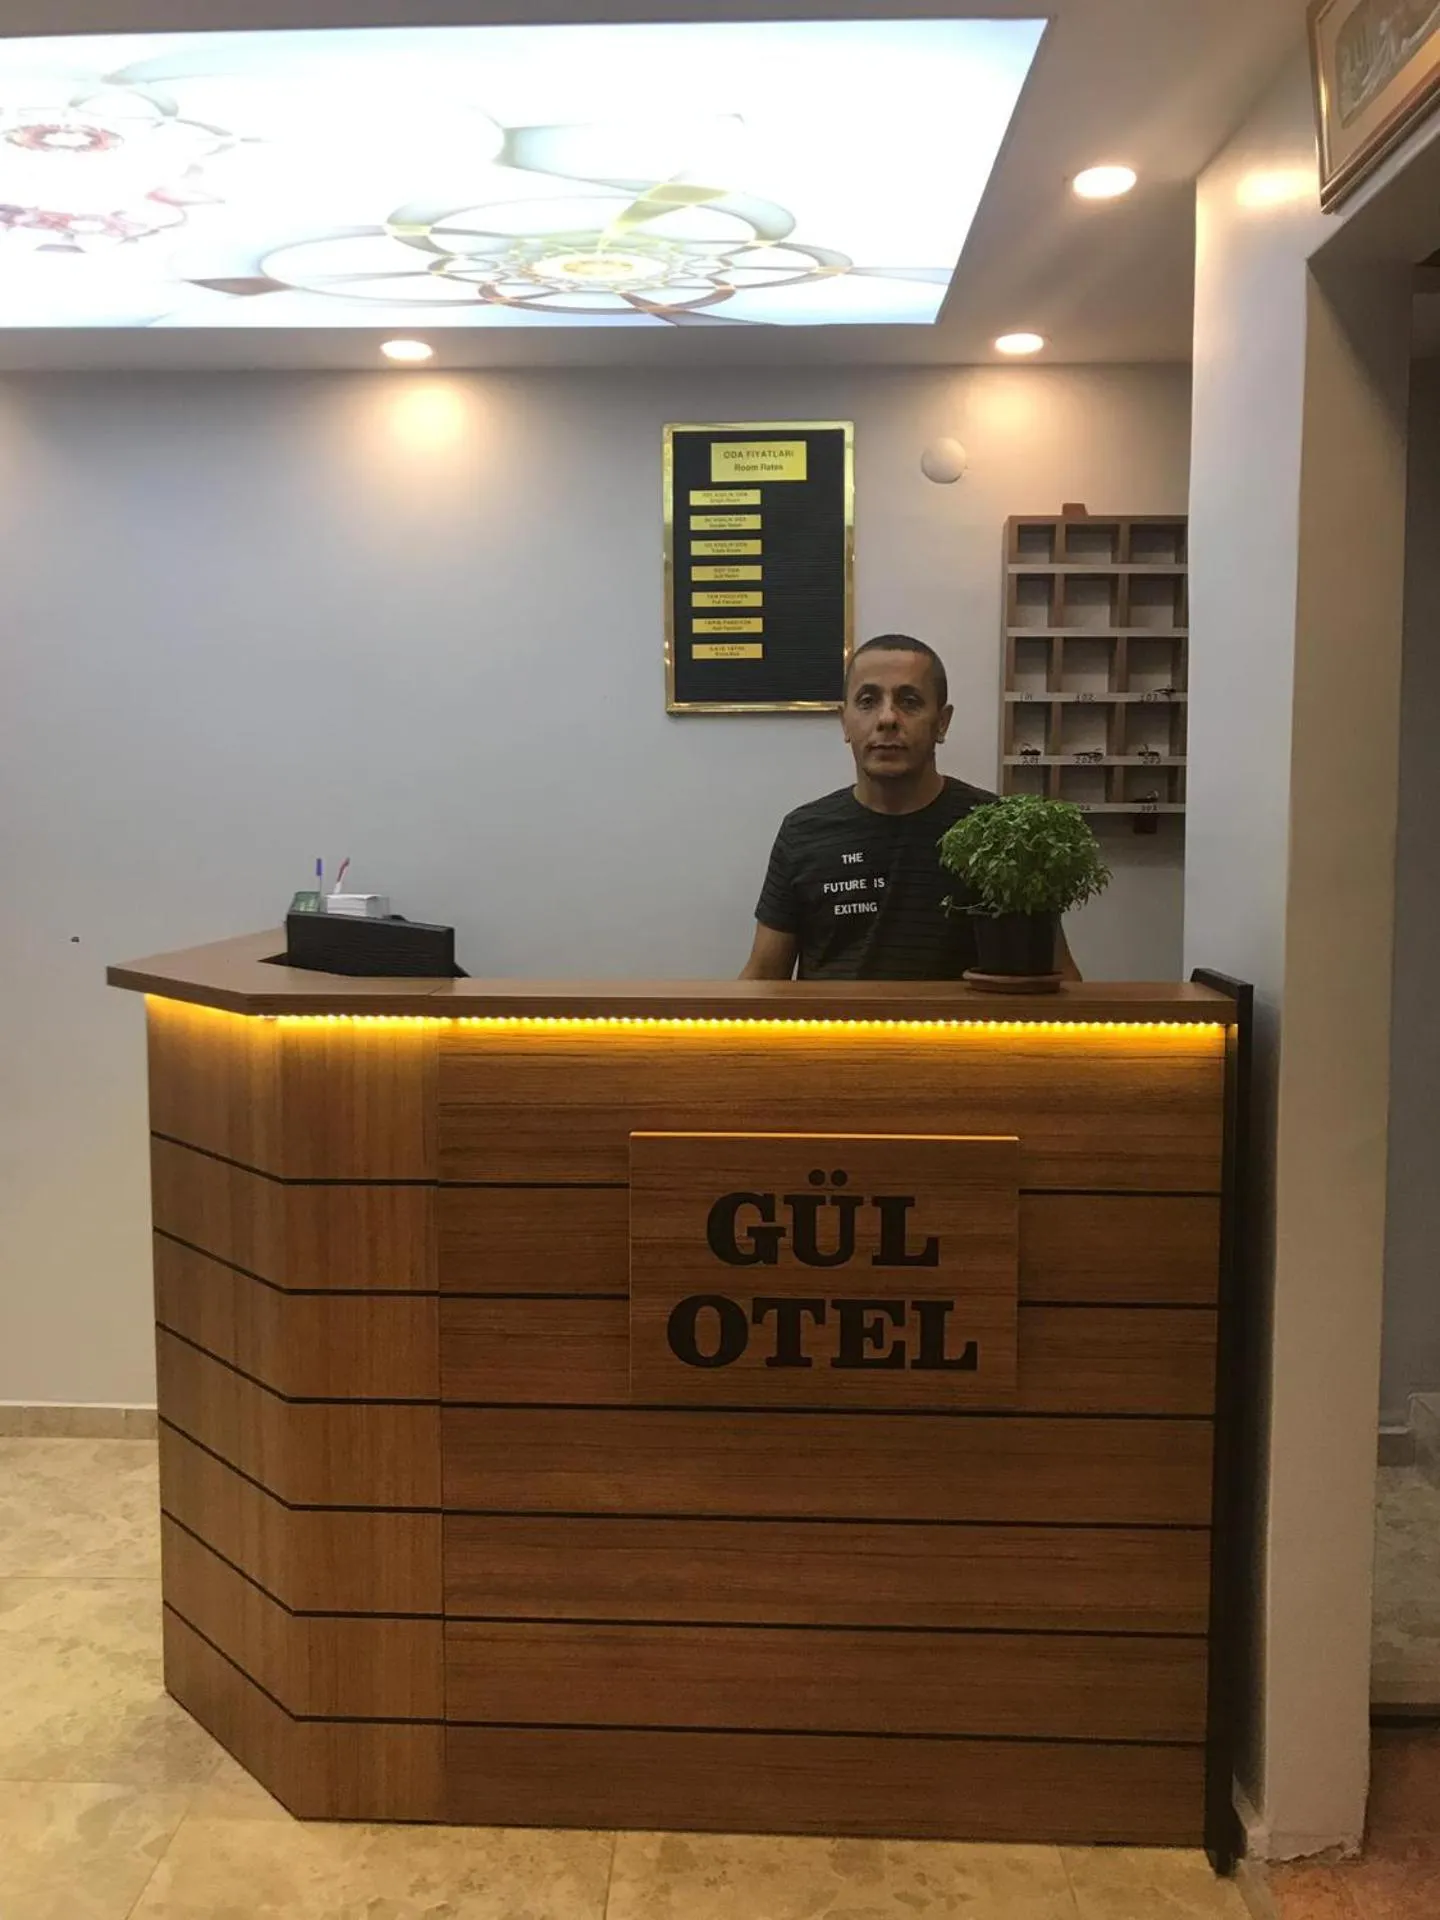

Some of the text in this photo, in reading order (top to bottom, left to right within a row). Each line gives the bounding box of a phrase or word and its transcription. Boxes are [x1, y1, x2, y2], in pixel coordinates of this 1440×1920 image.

[734, 463, 759, 472] Room
[841, 852, 864, 865] THE
[823, 877, 886, 894] FUTURE IS
[834, 902, 878, 916] EXITING
[706, 1168, 939, 1268] GÜL
[667, 1294, 978, 1370] OTEL
